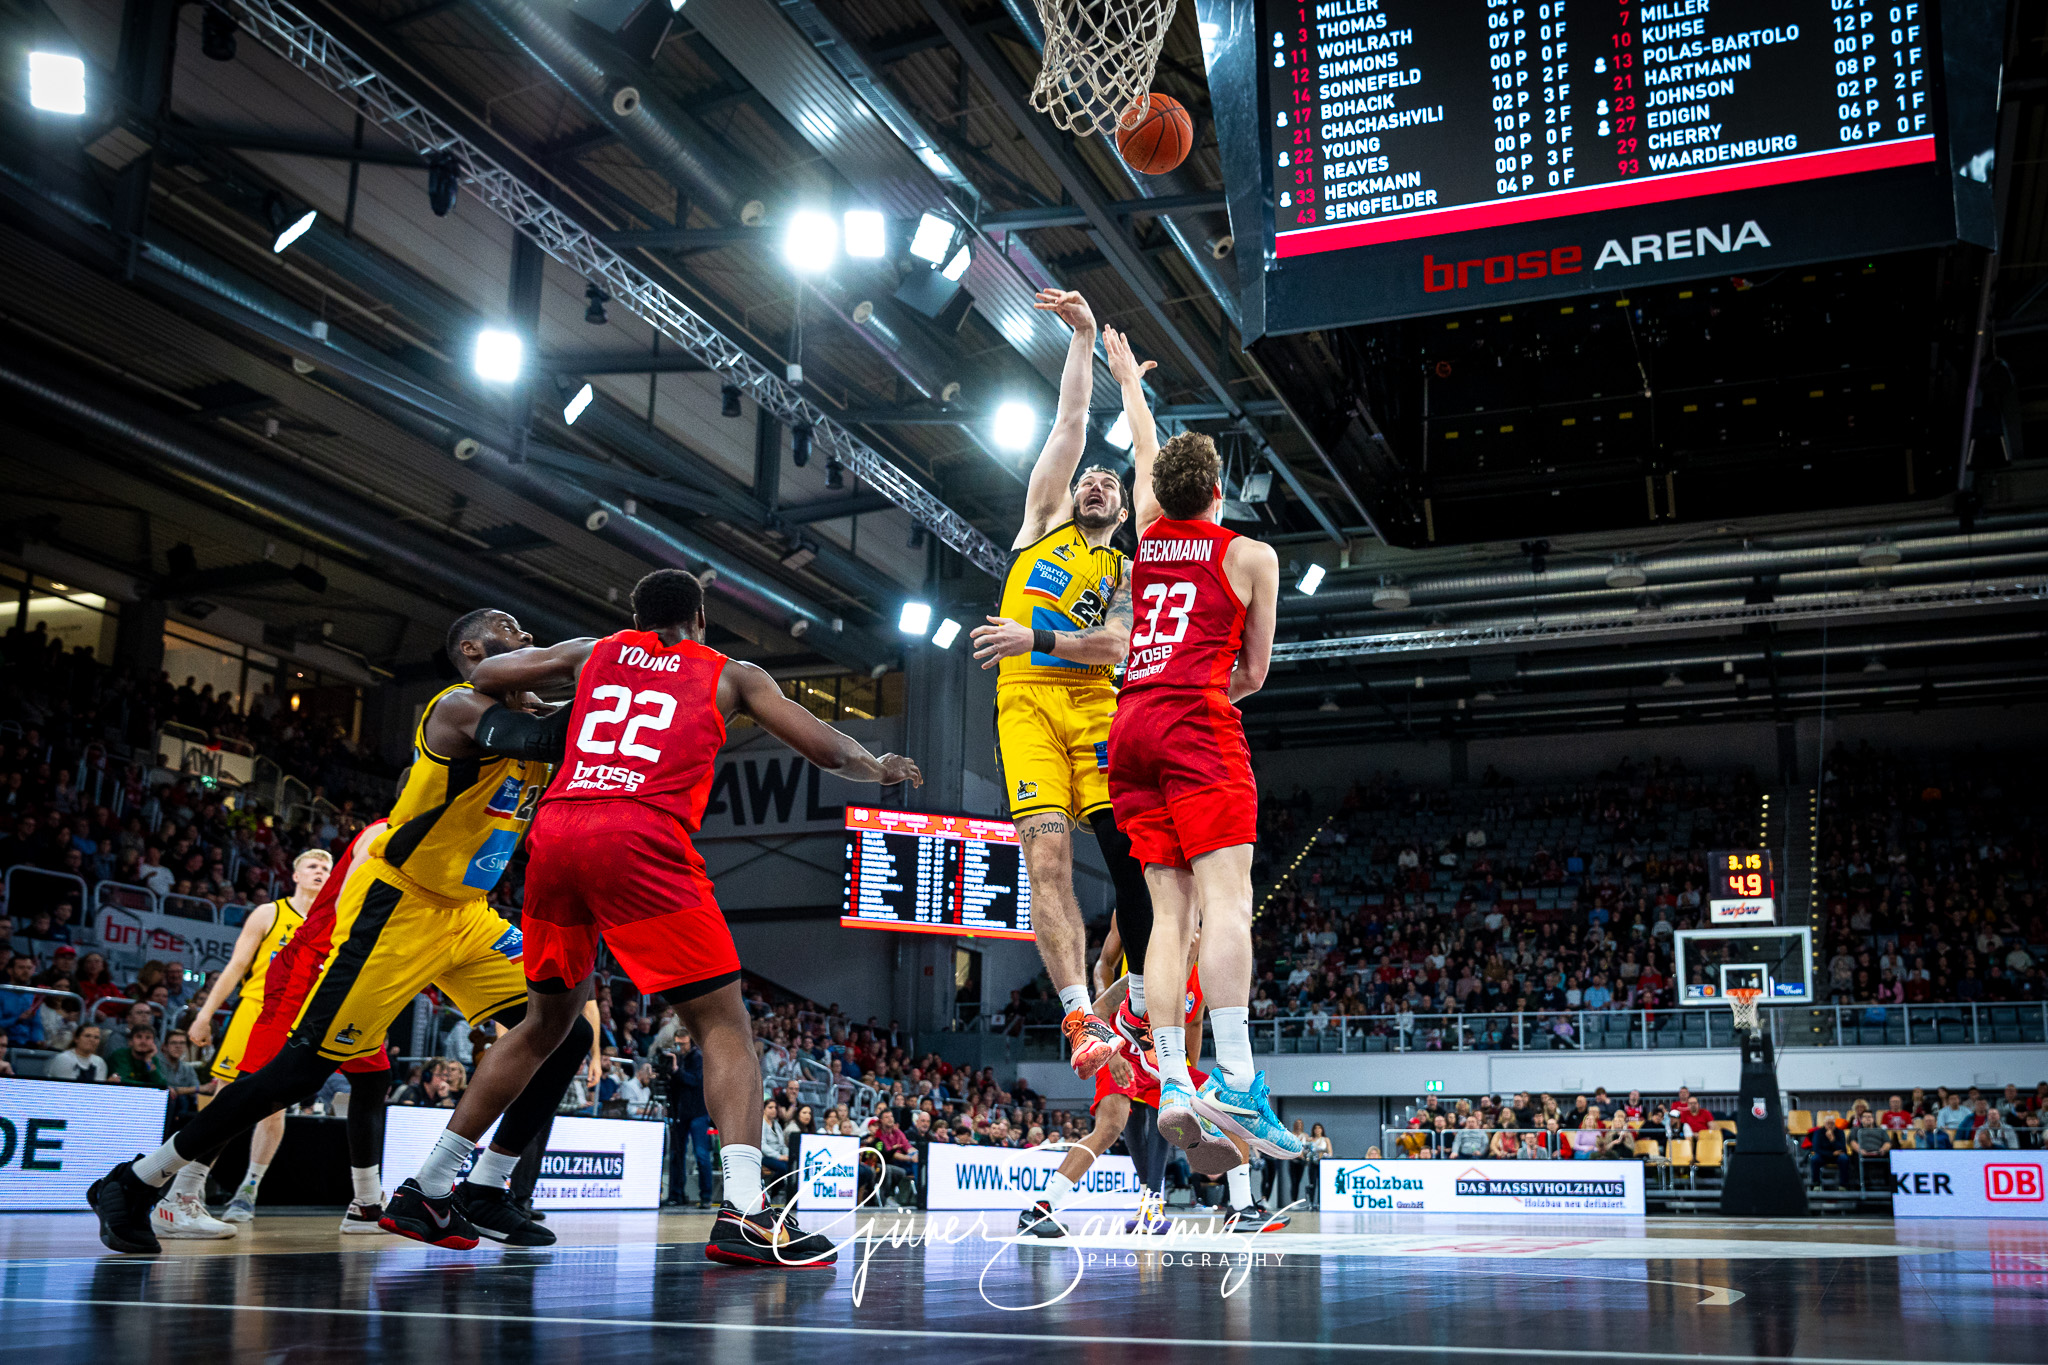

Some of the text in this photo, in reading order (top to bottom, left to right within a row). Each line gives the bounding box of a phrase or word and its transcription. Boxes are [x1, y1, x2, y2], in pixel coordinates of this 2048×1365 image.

[1291, 48, 1307, 64] 11
[1317, 28, 1413, 60] WOHLRATH
[1488, 11, 1509, 29] 06
[1513, 8, 1525, 25] P
[1539, 4, 1550, 20] 0
[1554, 0, 1566, 18] F
[1298, 0, 1378, 22] 1 MILLER
[1298, 13, 1387, 43] 3 THOMAS
[1612, 32, 1632, 48] 10
[1642, 18, 1705, 44] KUHSE
[1613, 3, 1918, 70] 13 POLAS-BARTOLO 12 P 0 F
[1620, 0, 1709, 26] 7 MILLER
[1292, 22, 1566, 84] 12 SIMMONS 07 P 0 F
[1293, 42, 1568, 104] 14 SONNEFELD 00 P 0 F
[1614, 25, 1920, 91] 21 HARTMANN 00 P 0 F
[1615, 47, 1922, 112] 23 JOHNSON 08 P 1 F
[1294, 63, 1569, 124] 17 BOHACIK 10 P 2 F
[1294, 84, 1570, 144] 21 CHACHASHVILI 02 P 3 F
[1616, 70, 1923, 133] 27 EDIGIN 02 P 2 F
[1294, 105, 1571, 164] 22 YOUNG 10 P 2 F
[1618, 92, 1924, 154] 29 CHERRY 06 P 1 F
[1618, 114, 1926, 175] 93 WAARDENBURG 06 P 0 F
[1295, 126, 1572, 184] 31 REAVES 00 P 0 F
[1296, 147, 1574, 204] 33 HECKMANN 00 P 3 F
[1296, 168, 1575, 224] 43 SENGFELDER 04 P 0 F
[1424, 220, 1771, 293] brose ARENA
[1035, 560, 1069, 582] Sparda
[1040, 570, 1066, 588] Bank
[1139, 539, 1214, 562] HECKMANN
[1132, 582, 1198, 647] 33
[618, 644, 682, 672] YOUNG
[576, 684, 678, 763] 22
[573, 760, 646, 784] brose
[1729, 873, 1762, 896] 4.9
[1352, 1176, 1424, 1190] Holzbau
[1352, 1190, 1394, 1208] Übel
[1457, 1182, 1624, 1195] DAS MASSIVHOLZHAUS
[1524, 1199, 1561, 1208] Holzbau
[1584, 1199, 1626, 1208] definiert.
[1891, 1170, 2036, 1195] KER DB
